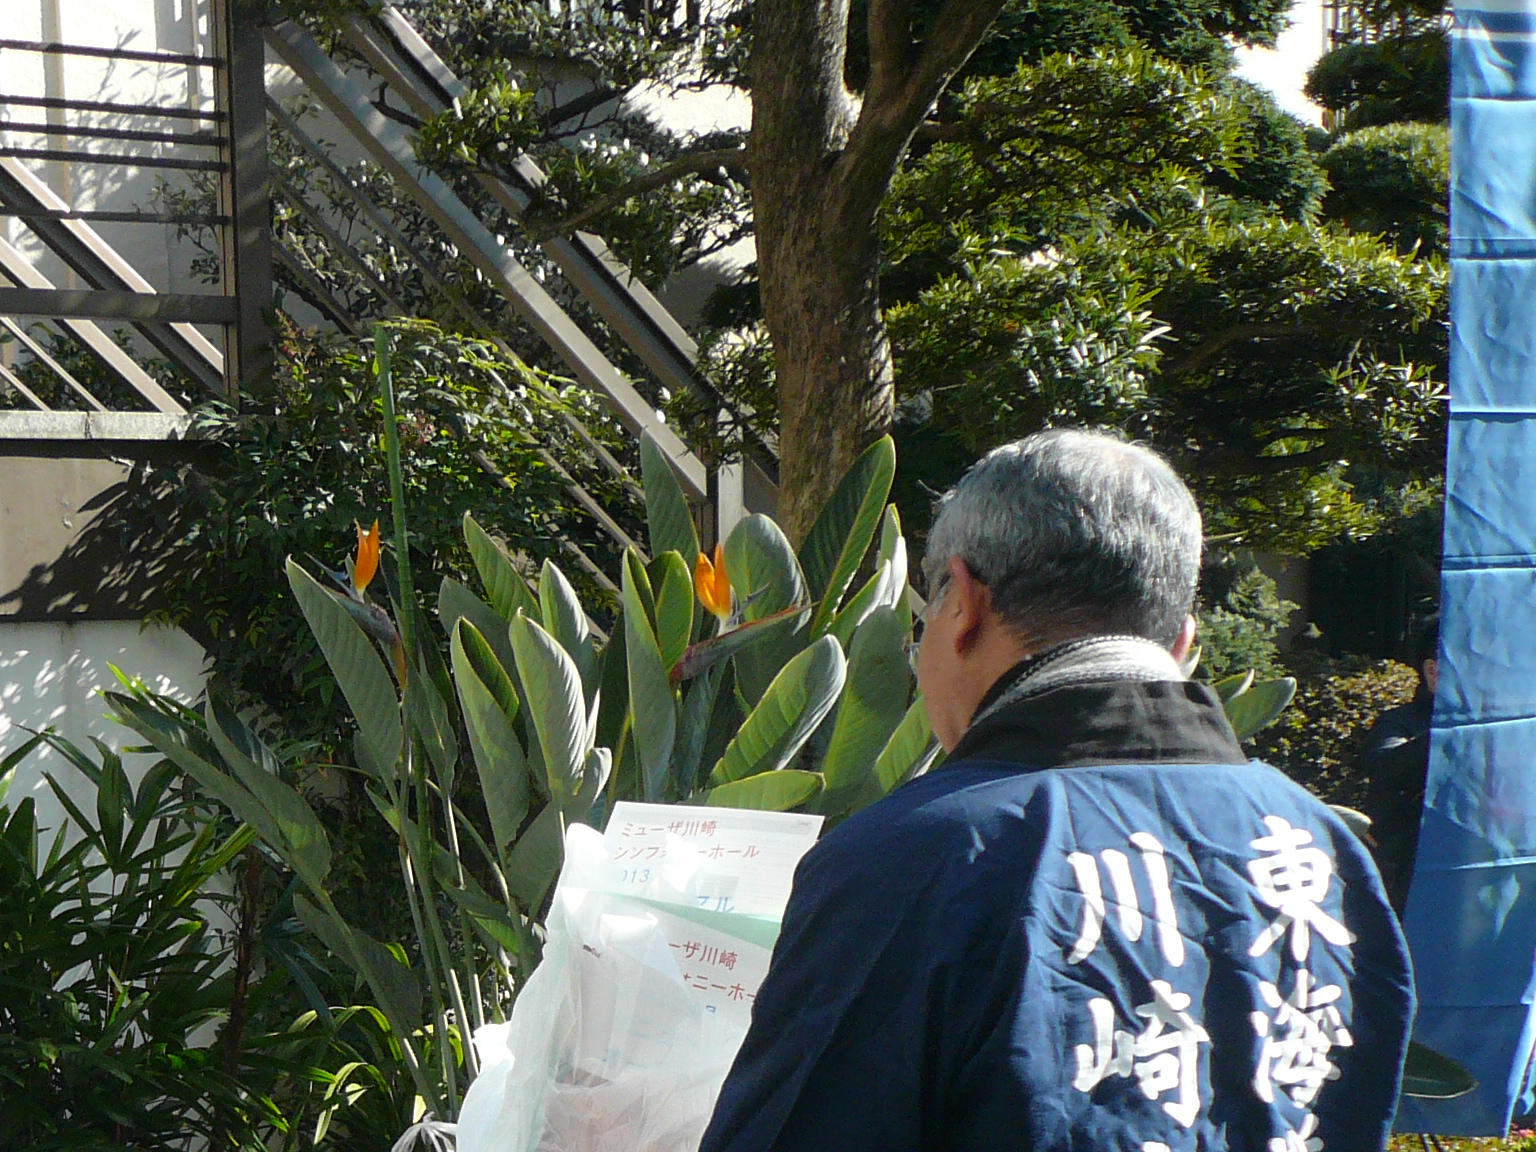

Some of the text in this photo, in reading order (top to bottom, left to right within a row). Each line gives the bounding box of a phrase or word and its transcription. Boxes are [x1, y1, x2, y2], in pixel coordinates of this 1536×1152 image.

[621, 820, 717, 838] ミューザ川崎
[614, 843, 760, 861] シンフーホール
